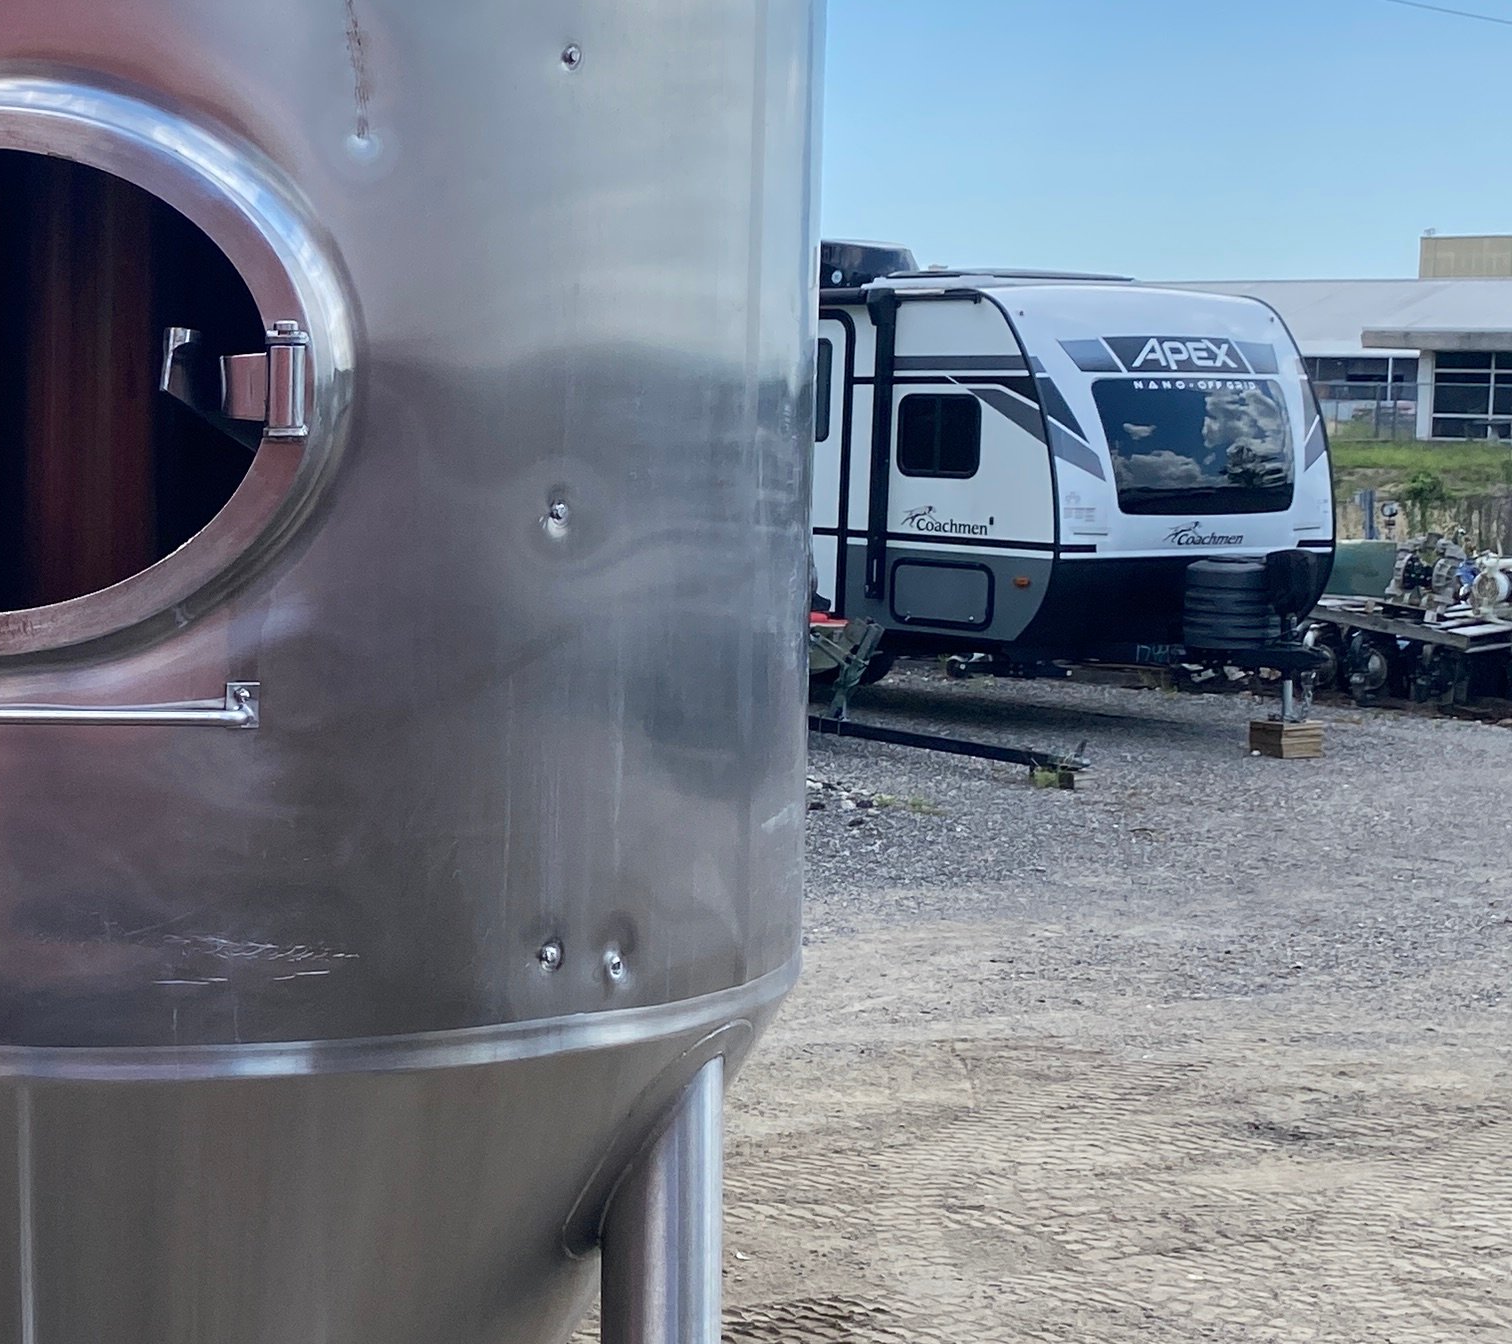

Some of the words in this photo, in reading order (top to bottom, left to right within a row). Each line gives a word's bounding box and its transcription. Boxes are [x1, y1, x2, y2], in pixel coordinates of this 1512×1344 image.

[1132, 338, 1238, 370] APEX
[916, 518, 988, 536] Coachmen
[1177, 532, 1244, 546] Coachmen
